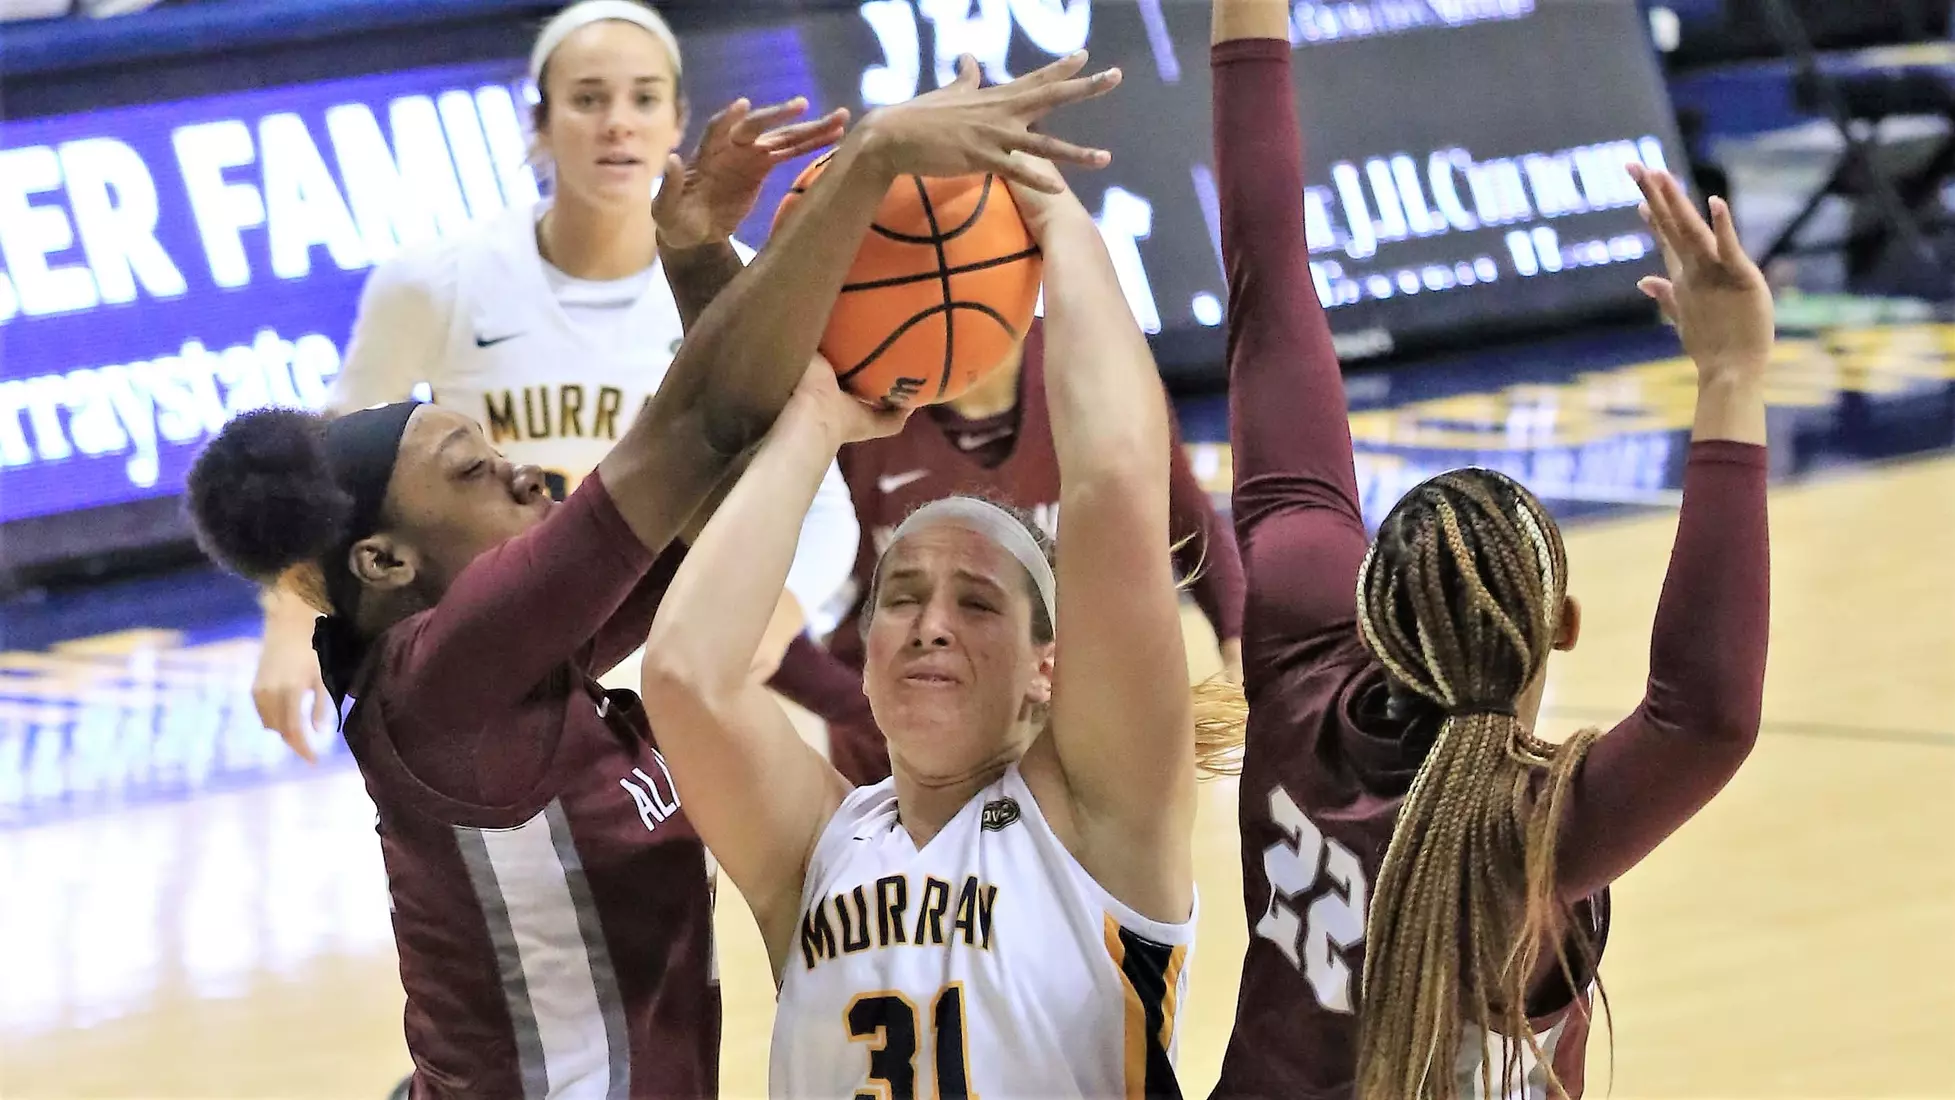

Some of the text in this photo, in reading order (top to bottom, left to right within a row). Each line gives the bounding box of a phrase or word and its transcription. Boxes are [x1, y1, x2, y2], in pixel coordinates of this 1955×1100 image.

[0, 80, 542, 325] ER FAMIL
[483, 382, 656, 443] MURR
[799, 873, 999, 974] MURRAY
[1255, 783, 1368, 1015] 22
[842, 979, 981, 1100] 31
